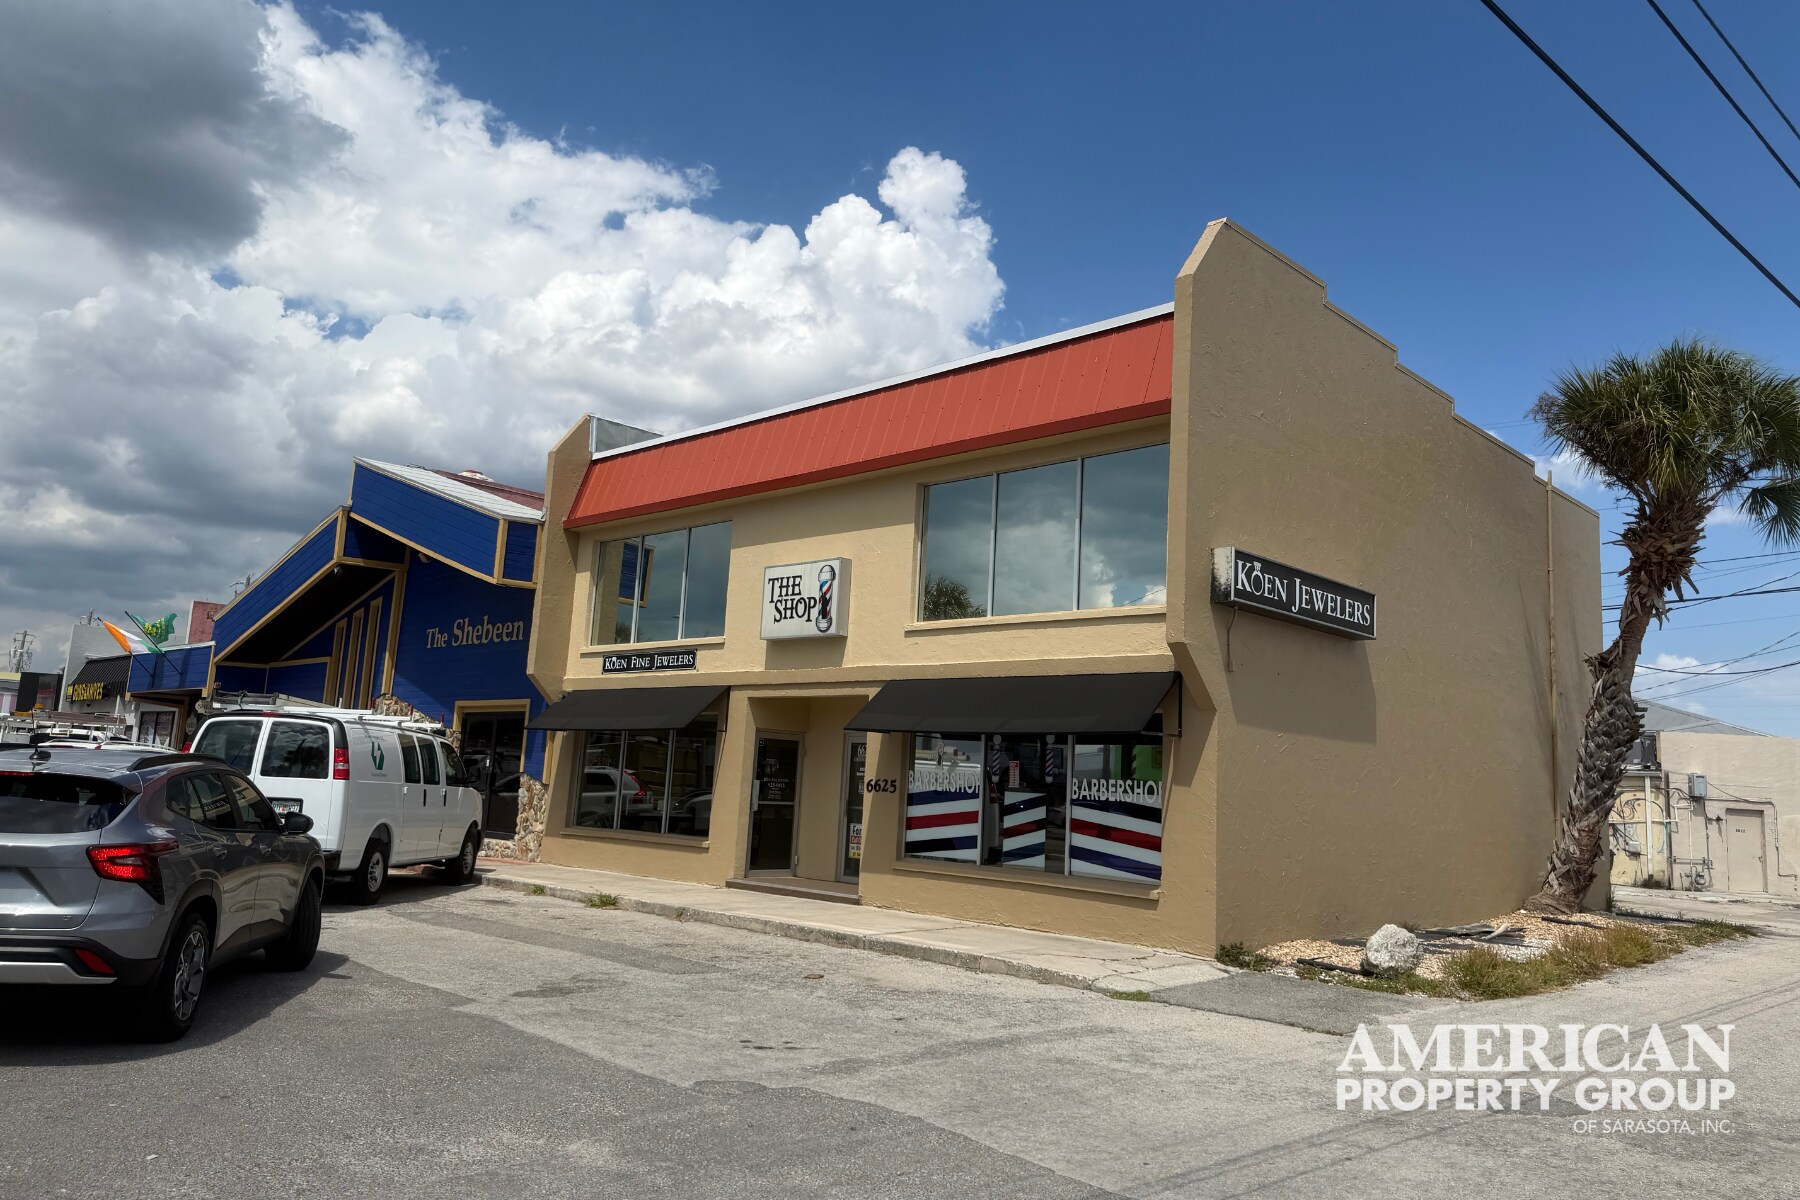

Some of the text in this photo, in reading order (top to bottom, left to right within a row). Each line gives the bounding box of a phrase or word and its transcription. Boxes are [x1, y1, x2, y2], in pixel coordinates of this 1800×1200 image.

[768, 575, 802, 603] THE
[1236, 560, 1371, 626] KOEN JEWELERS
[774, 597, 817, 624] SHOP
[426, 615, 524, 648] The Shebeen
[605, 655, 694, 670] KOEN FINE JEWELERS
[866, 779, 897, 793] 6625
